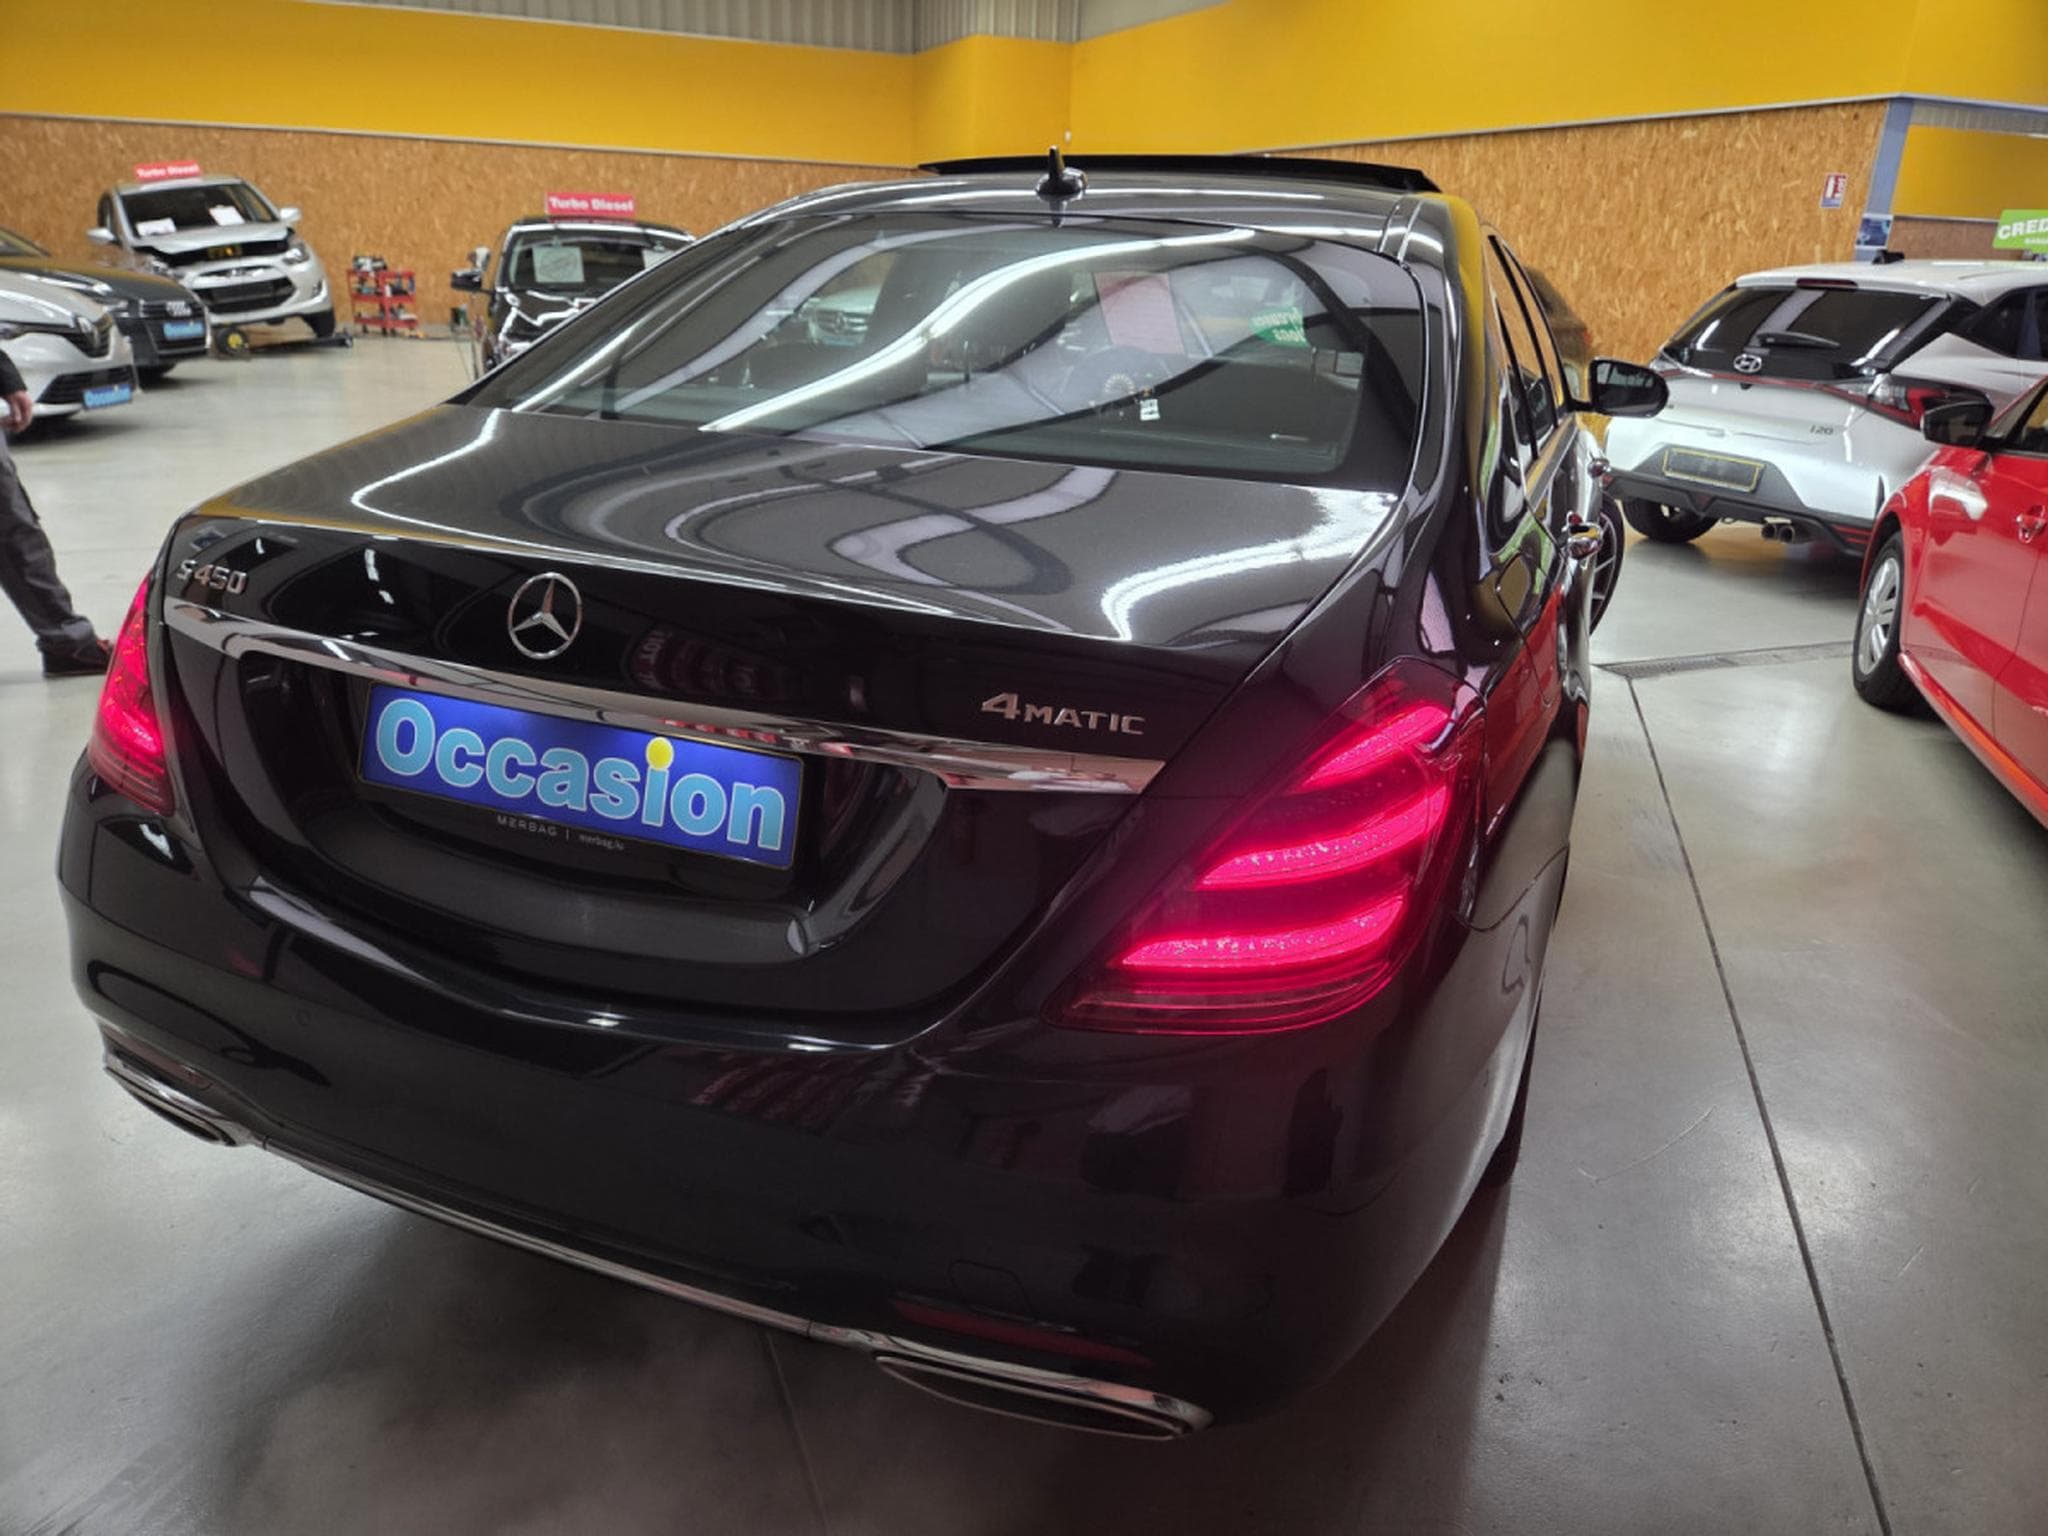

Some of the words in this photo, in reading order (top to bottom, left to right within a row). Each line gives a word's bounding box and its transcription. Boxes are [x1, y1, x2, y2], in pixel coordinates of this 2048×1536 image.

[548, 196, 590, 209] Turbo
[591, 198, 634, 211] Diesel
[980, 692, 1146, 735] 4MATIC
[375, 698, 786, 851] Occasion
